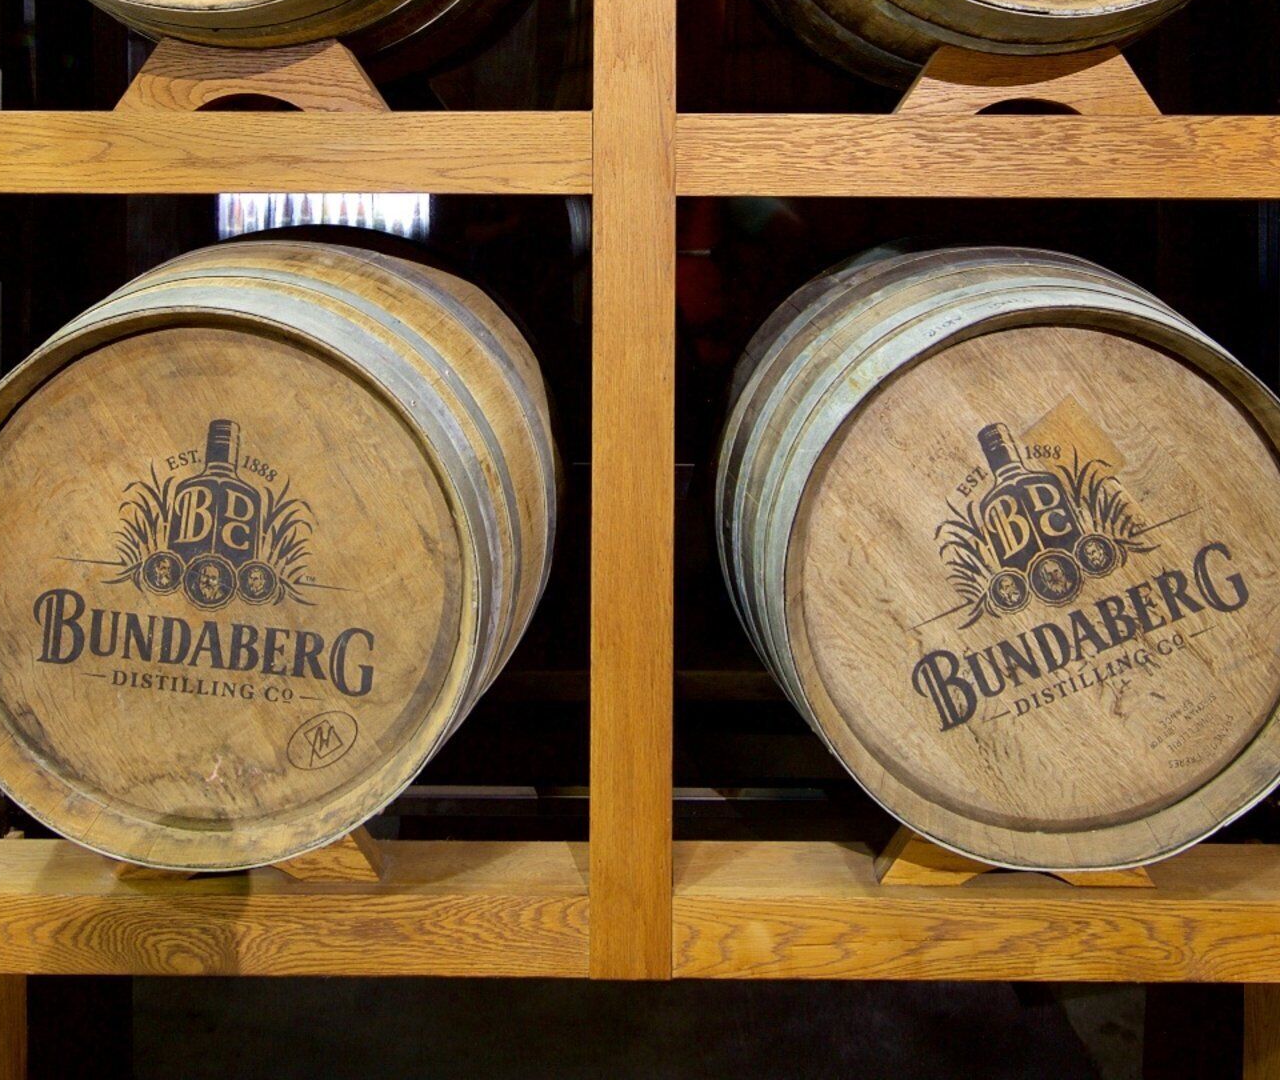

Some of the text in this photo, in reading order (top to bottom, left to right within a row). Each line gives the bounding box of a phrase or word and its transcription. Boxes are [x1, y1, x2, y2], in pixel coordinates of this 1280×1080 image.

[166, 450, 277, 482] EST. 1888
[956, 443, 1062, 498] EST. 1888
[33, 588, 376, 698] BUNDABERG
[912, 540, 1250, 733] BUNDABERG
[112, 670, 255, 701] DISTILLING
[1013, 649, 1150, 717] DISTILLING
